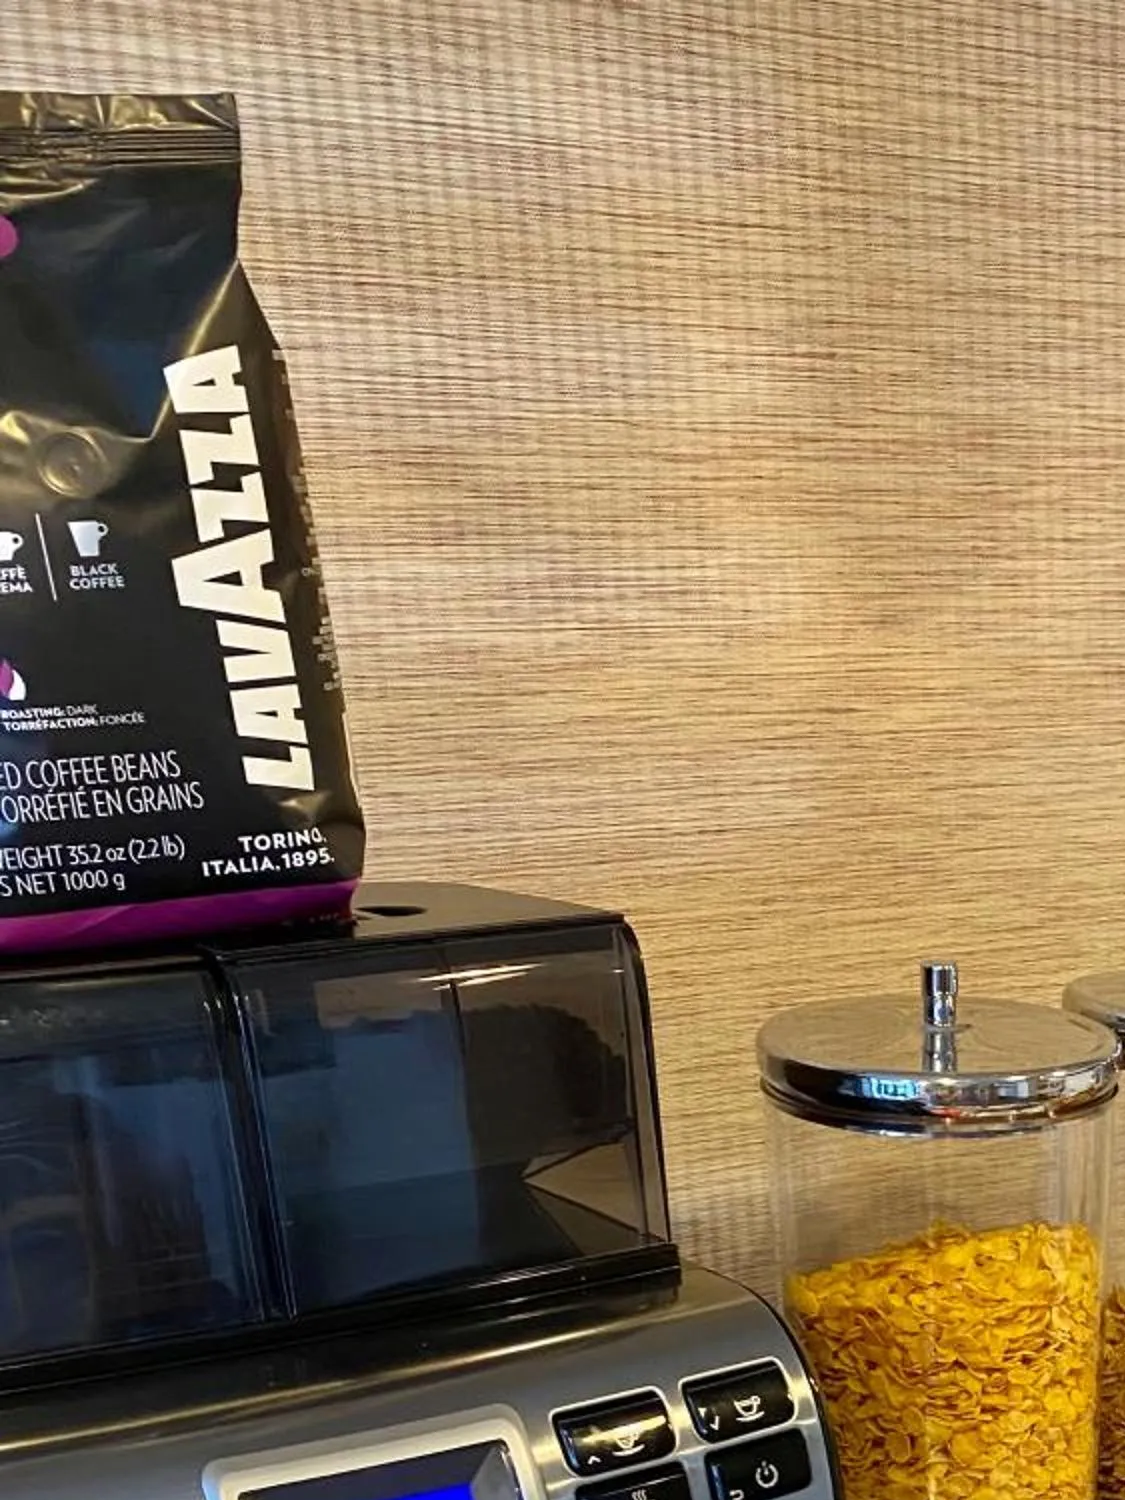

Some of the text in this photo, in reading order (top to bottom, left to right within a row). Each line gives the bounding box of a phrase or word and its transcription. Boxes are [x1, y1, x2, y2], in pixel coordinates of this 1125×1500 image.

[69, 563, 118, 577] BLACK
[163, 345, 315, 792] LAVAZZA
[69, 576, 125, 590] COFFEE
[66, 704, 99, 716] DARK
[25, 756, 110, 789] COFFEE
[111, 749, 181, 784] BEANS
[1, 781, 205, 824] ORRÉFIÉ EN GRAINS
[105, 848, 127, 862] oz
[16, 872, 57, 896] NET
[61, 869, 109, 892] 1000
[113, 873, 126, 891] g
